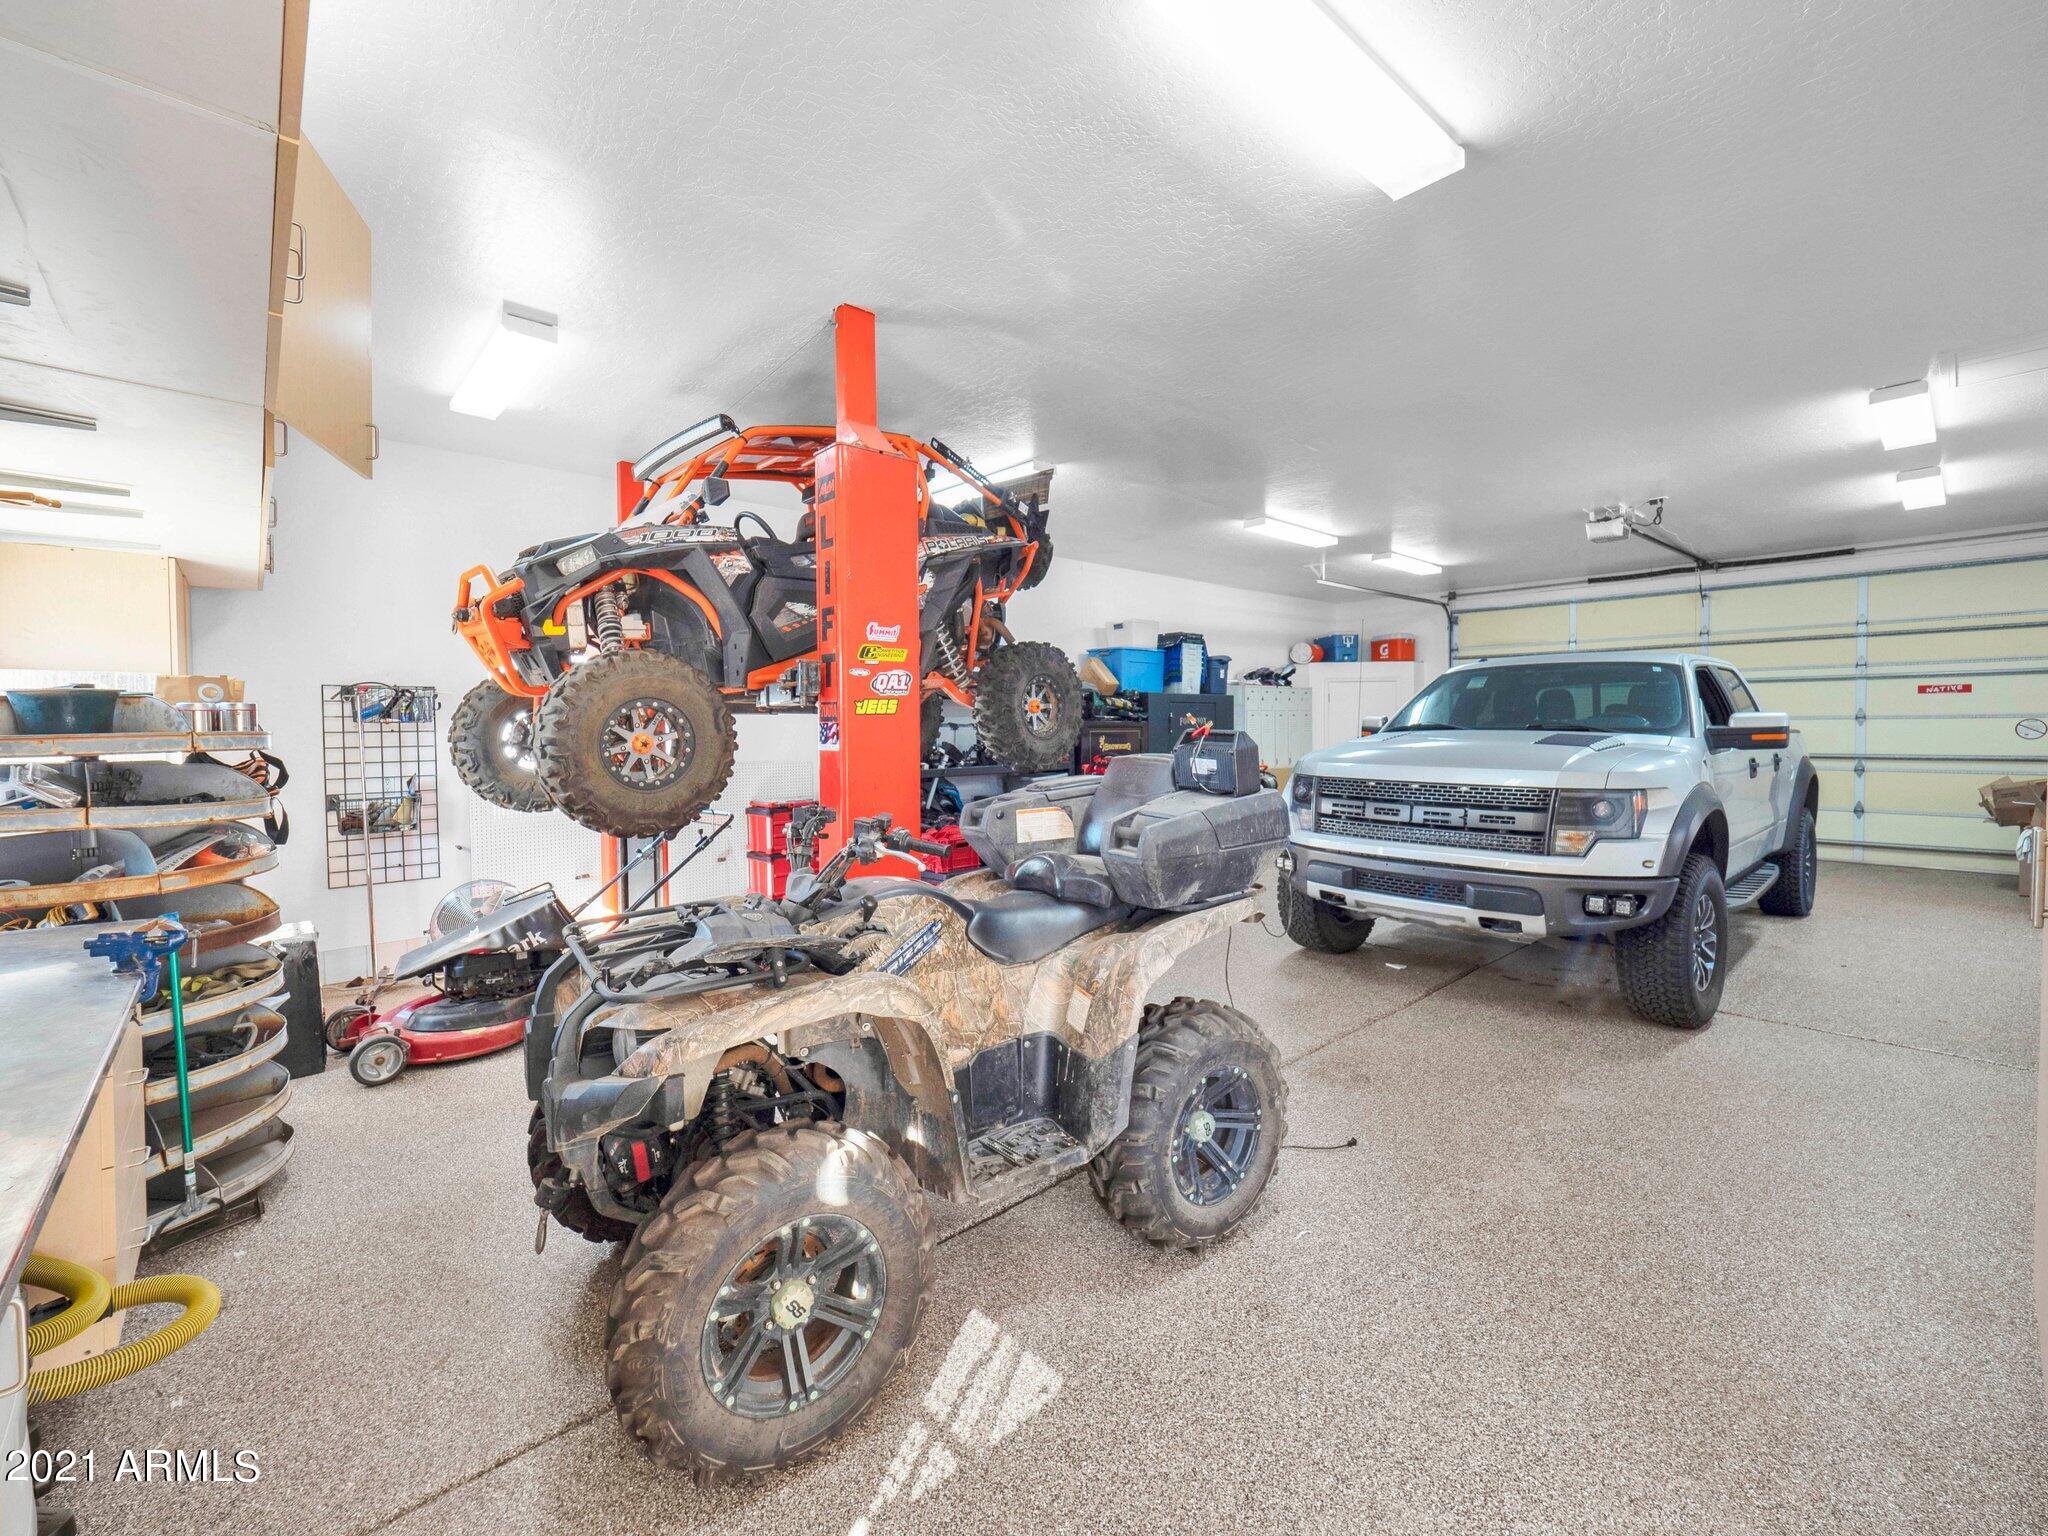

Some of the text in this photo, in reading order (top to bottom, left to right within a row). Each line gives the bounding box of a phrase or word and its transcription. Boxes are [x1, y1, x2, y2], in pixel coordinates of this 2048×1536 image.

[640, 528, 718, 542] 1000
[876, 674, 908, 693] QA1
[1926, 685, 1963, 693] NATIVE
[855, 700, 899, 714] JEGS
[1321, 799, 1548, 832] FORD
